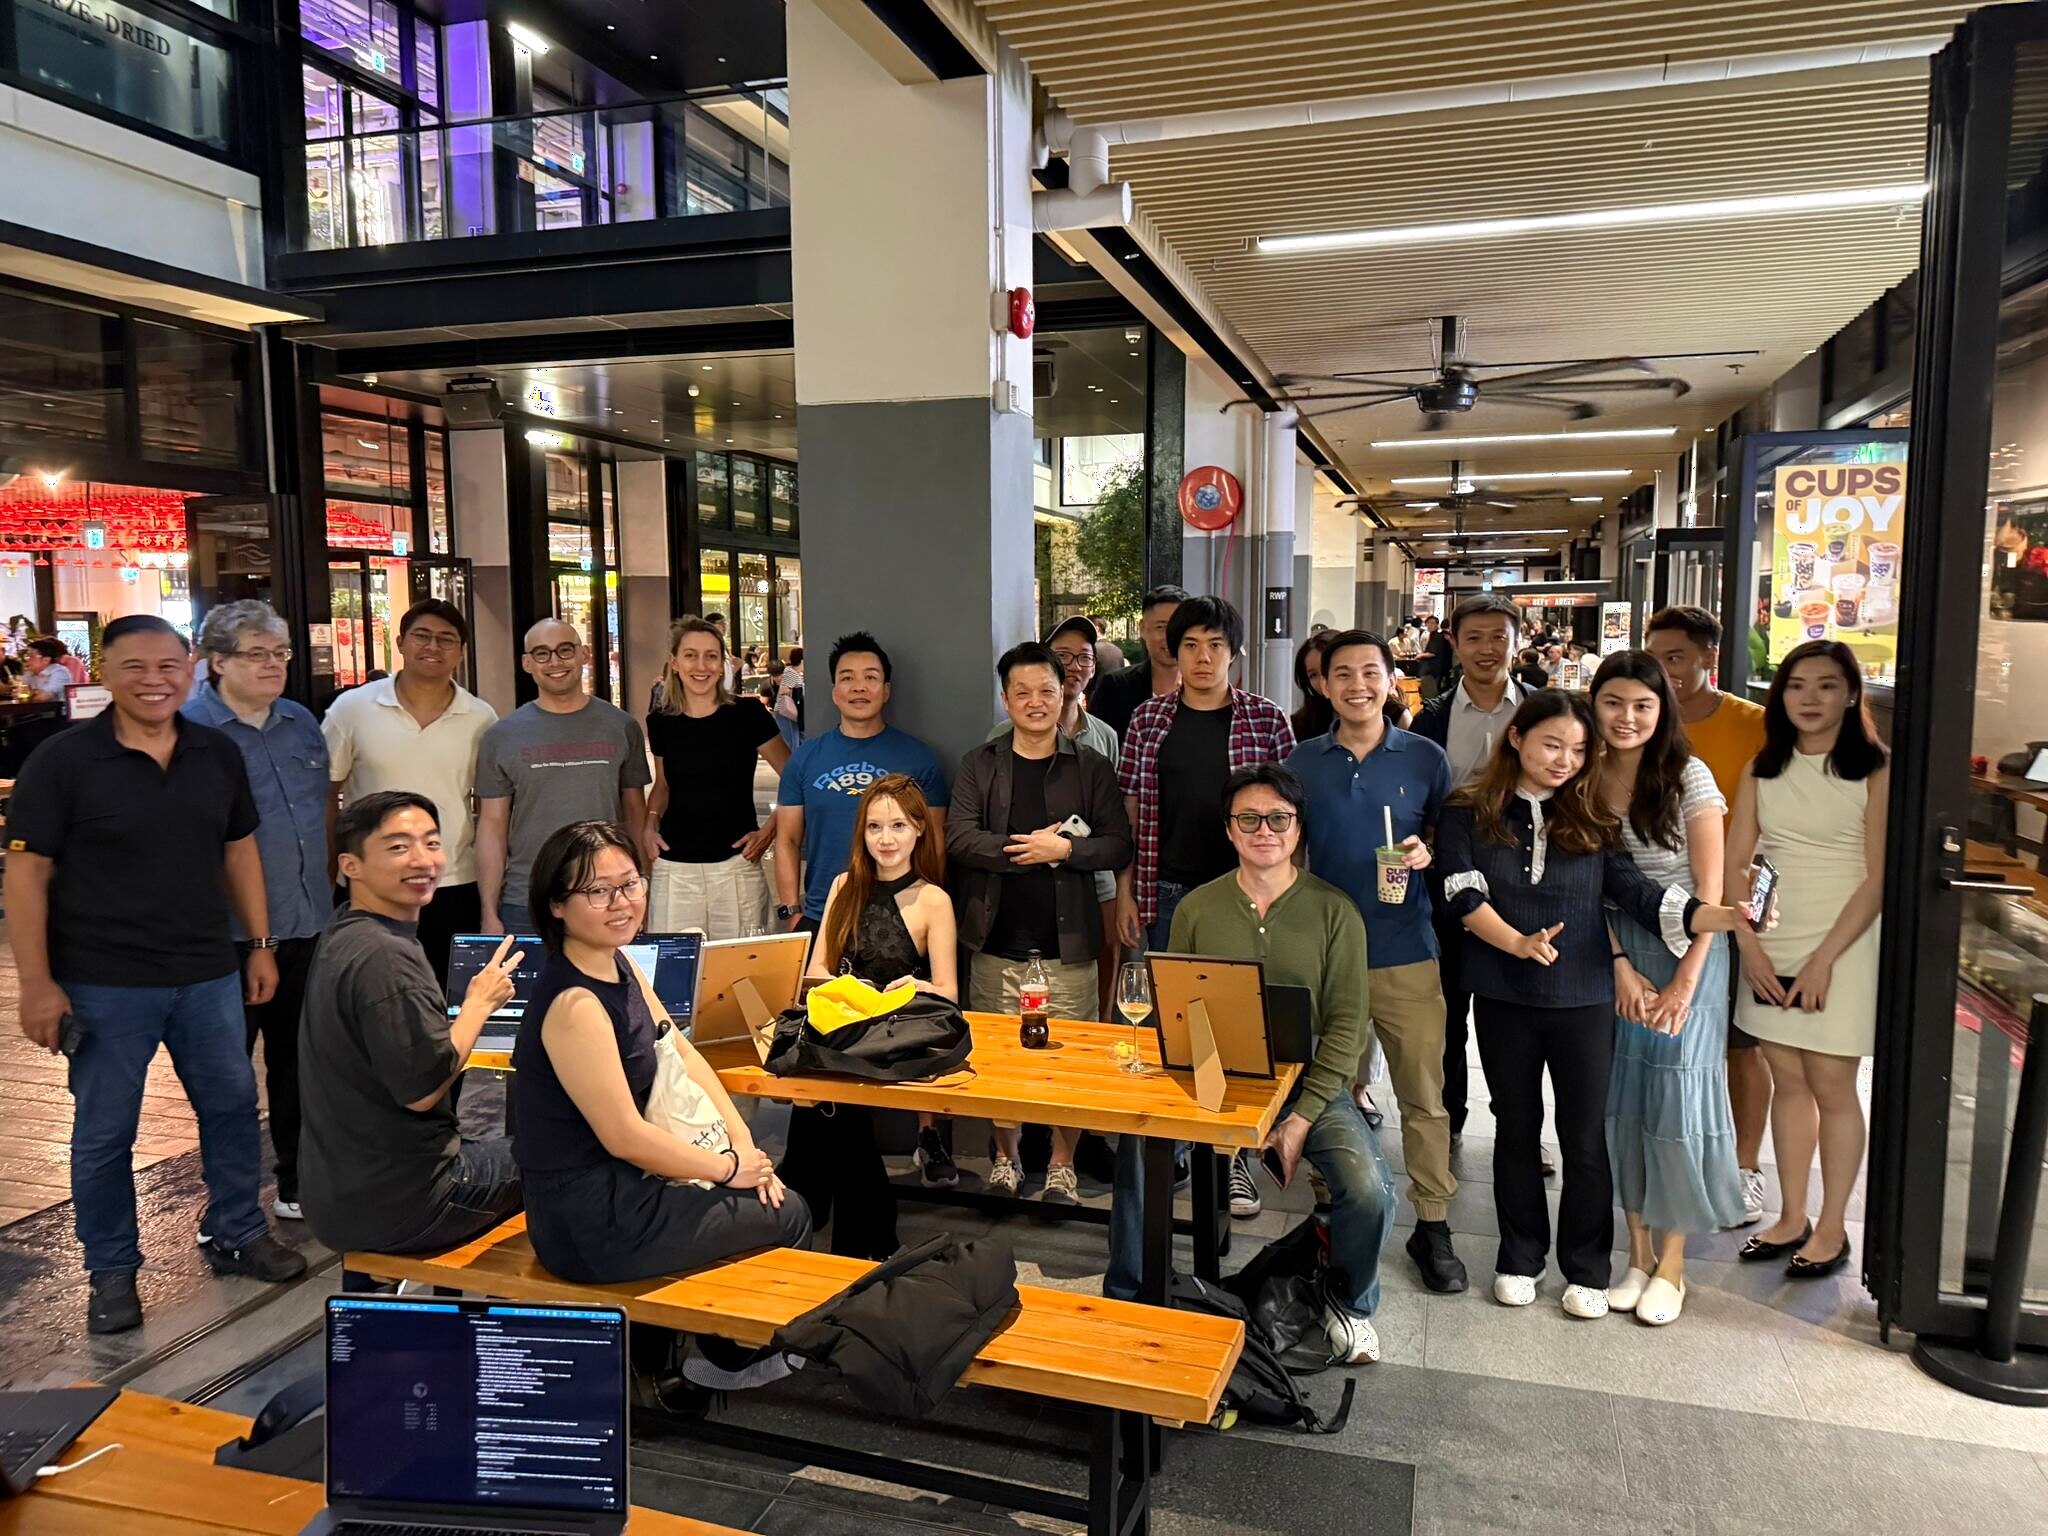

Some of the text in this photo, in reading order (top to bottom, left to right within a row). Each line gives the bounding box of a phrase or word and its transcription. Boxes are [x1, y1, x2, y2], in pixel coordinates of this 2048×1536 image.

[1785, 466, 1901, 498] CUPS
[1785, 496, 1904, 536] OF JOY
[1269, 591, 1288, 600] RWP
[812, 761, 889, 790] Reebo
[827, 772, 874, 792] 189
[1386, 867, 1408, 876] CUP
